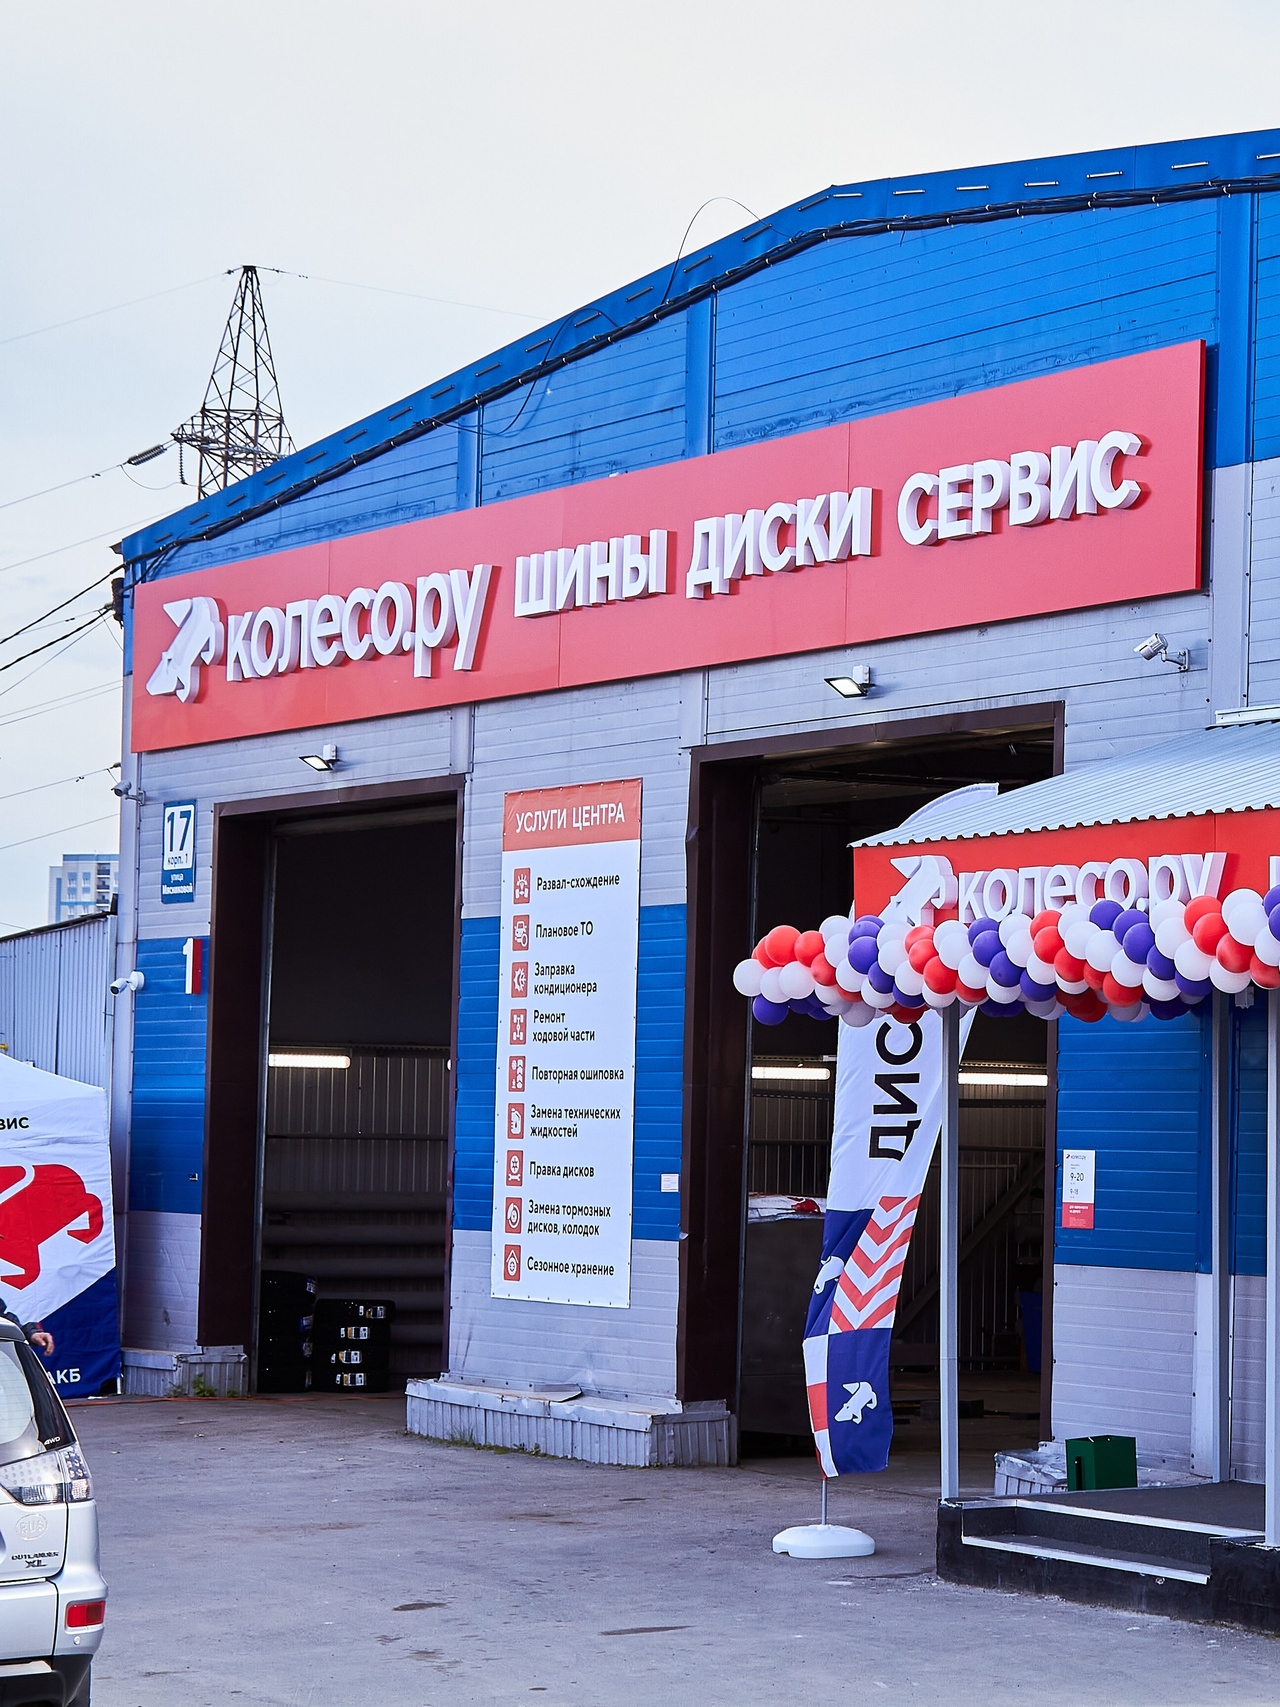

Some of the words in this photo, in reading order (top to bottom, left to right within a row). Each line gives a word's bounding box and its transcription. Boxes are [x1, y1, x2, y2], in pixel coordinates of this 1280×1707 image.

[226, 563, 494, 682] колесо.ру
[514, 529, 668, 618] ШИНЫ
[685, 487, 872, 599] ДИСКИ
[898, 430, 1142, 546] СЕРВИС
[515, 808, 567, 834] УСЛУГИ
[572, 802, 625, 831] ЦЕНТРА
[167, 809, 192, 852] 17
[536, 873, 620, 891] Развал-схождение
[958, 852, 1228, 924] колесо.ру
[535, 924, 578, 938] Плановое
[580, 921, 594, 935] ТО
[534, 962, 575, 978] Заправка
[533, 980, 597, 997] кондиционера
[533, 1010, 566, 1024] Ремонт
[532, 1027, 569, 1044] ходовой
[570, 1030, 595, 1041] части
[531, 1066, 578, 1084] Повторная
[579, 1068, 624, 1081] ошиповка
[530, 1104, 562, 1119] Замена
[564, 1106, 621, 1120] технических
[530, 1124, 578, 1139] жидкостей
[529, 1161, 561, 1178] Правка
[562, 1165, 595, 1179] дисков
[528, 1199, 560, 1215] Замена
[561, 1204, 611, 1218] тормозных
[527, 1222, 560, 1235] дисков,
[562, 1223, 600, 1237] колодок
[526, 1256, 570, 1275] Сезонное
[570, 1262, 615, 1277] хранение
[25, 1559, 48, 1568] XL
